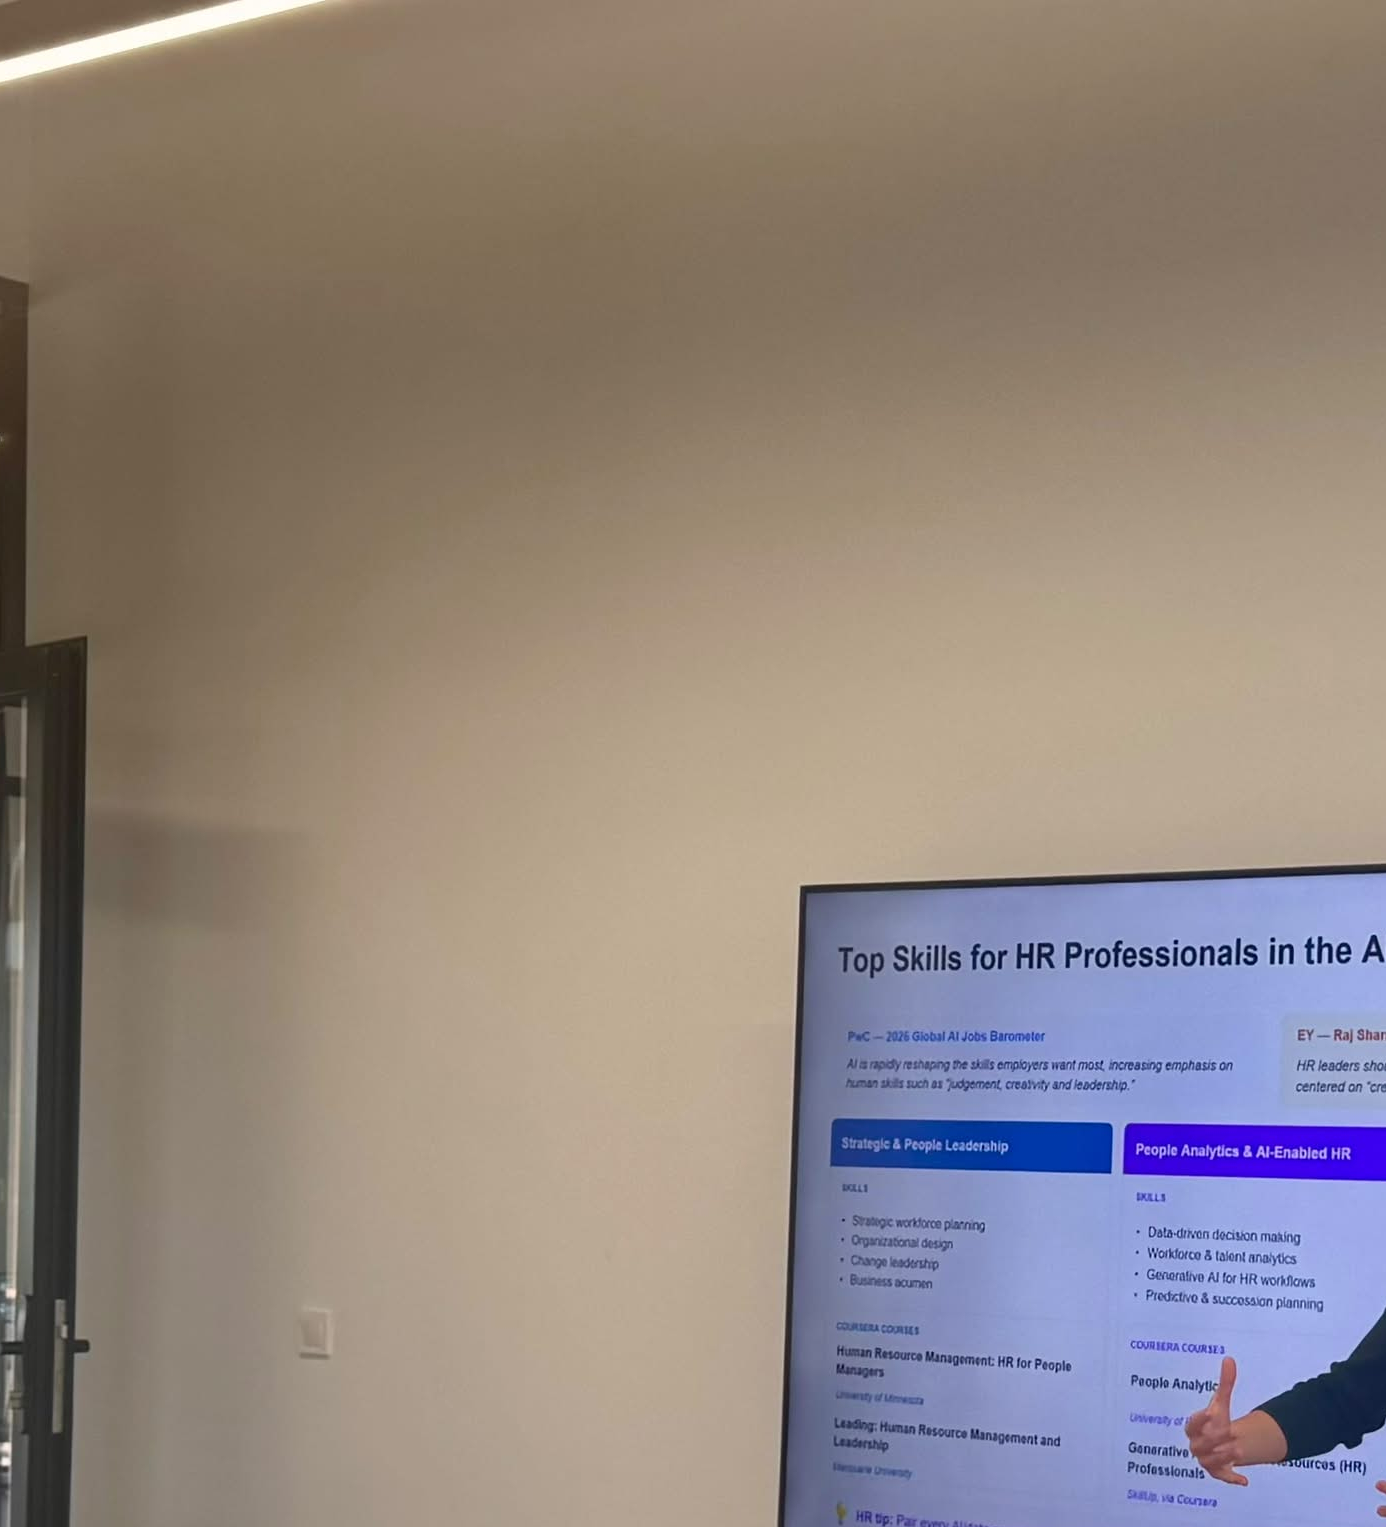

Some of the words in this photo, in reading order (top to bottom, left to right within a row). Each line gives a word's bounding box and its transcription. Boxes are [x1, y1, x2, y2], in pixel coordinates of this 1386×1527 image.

[839, 947, 884, 978] Top
[893, 945, 961, 971] Skills
[970, 943, 1008, 970] for
[1016, 942, 1055, 969] HR
[1065, 938, 1258, 968] Professionals
[1269, 937, 1294, 965] in
[1304, 936, 1352, 964] the
[1297, 1029, 1314, 1041] EY
[1333, 1028, 1353, 1043] Raj
[847, 1058, 857, 1069] AI
[870, 1059, 901, 1072] rapidly
[903, 1060, 950, 1072] reshaping
[953, 1060, 968, 1070] the
[970, 1059, 995, 1070] skills
[997, 1059, 1049, 1072] employers
[1051, 1060, 1076, 1070] want
[1108, 1060, 1163, 1074] increasing
[1165, 1060, 1217, 1073] emphasis
[1219, 1061, 1233, 1071] on
[1296, 1059, 1315, 1072] HR
[1318, 1060, 1360, 1072] leaders
[1296, 1081, 1346, 1092] centered
[1348, 1083, 1363, 1093] on
[842, 1137, 890, 1152] Strategic
[893, 1138, 901, 1149] &
[904, 1138, 942, 1154] People
[945, 1139, 1009, 1155] Leadership
[1136, 1143, 1177, 1159] People
[1181, 1144, 1239, 1160] Analytics
[1243, 1145, 1252, 1157] &
[1256, 1145, 1327, 1159] AI-Enabled
[1331, 1147, 1351, 1160] HR
[1136, 1192, 1166, 1202] SKILLS
[852, 1214, 893, 1229] Strategic
[895, 1217, 942, 1229] workforce
[944, 1219, 985, 1233] planning
[851, 1234, 919, 1248] Organizational
[921, 1238, 953, 1252] design
[1148, 1226, 1209, 1239] Data-driven
[1212, 1229, 1257, 1241] decision
[1260, 1231, 1301, 1246] making
[850, 1254, 887, 1269] Change
[890, 1256, 939, 1272] leadership
[1147, 1247, 1201, 1261] Workforce
[1204, 1249, 1212, 1261] &
[1215, 1250, 1245, 1263] talent
[1248, 1252, 1297, 1266] analytics
[850, 1273, 893, 1287] Business
[894, 1278, 933, 1289] acumen
[1147, 1268, 1204, 1282] Generative
[1207, 1272, 1219, 1283] AI
[1222, 1272, 1237, 1284] for
[1240, 1272, 1257, 1285] HR
[1261, 1274, 1315, 1288] workflows
[1146, 1289, 1198, 1304] Predictive
[1201, 1292, 1209, 1304] &
[1212, 1295, 1273, 1307] succession
[1276, 1297, 1323, 1312] planning
[837, 1345, 872, 1358] Human
[875, 1347, 923, 1362] Resource
[925, 1351, 994, 1367] Management:
[998, 1356, 1013, 1368] HR
[1017, 1357, 1032, 1369] for
[1035, 1358, 1071, 1373] People
[836, 1363, 884, 1378] Managers
[1131, 1374, 1169, 1390] People
[1172, 1378, 1219, 1394] Analytic
[834, 1418, 877, 1433] Leading:
[880, 1421, 916, 1434] Human
[918, 1424, 967, 1439] Resource
[970, 1428, 1038, 1445] Management
[1040, 1436, 1061, 1447] and
[833, 1435, 889, 1453] Leadership
[1128, 1441, 1190, 1457] Generative
[1277, 1458, 1335, 1471] sources
[1340, 1460, 1366, 1476] (HR)
[1127, 1462, 1205, 1479] Professionals
[856, 1510, 872, 1523] HR
[875, 1513, 893, 1527] tip:
